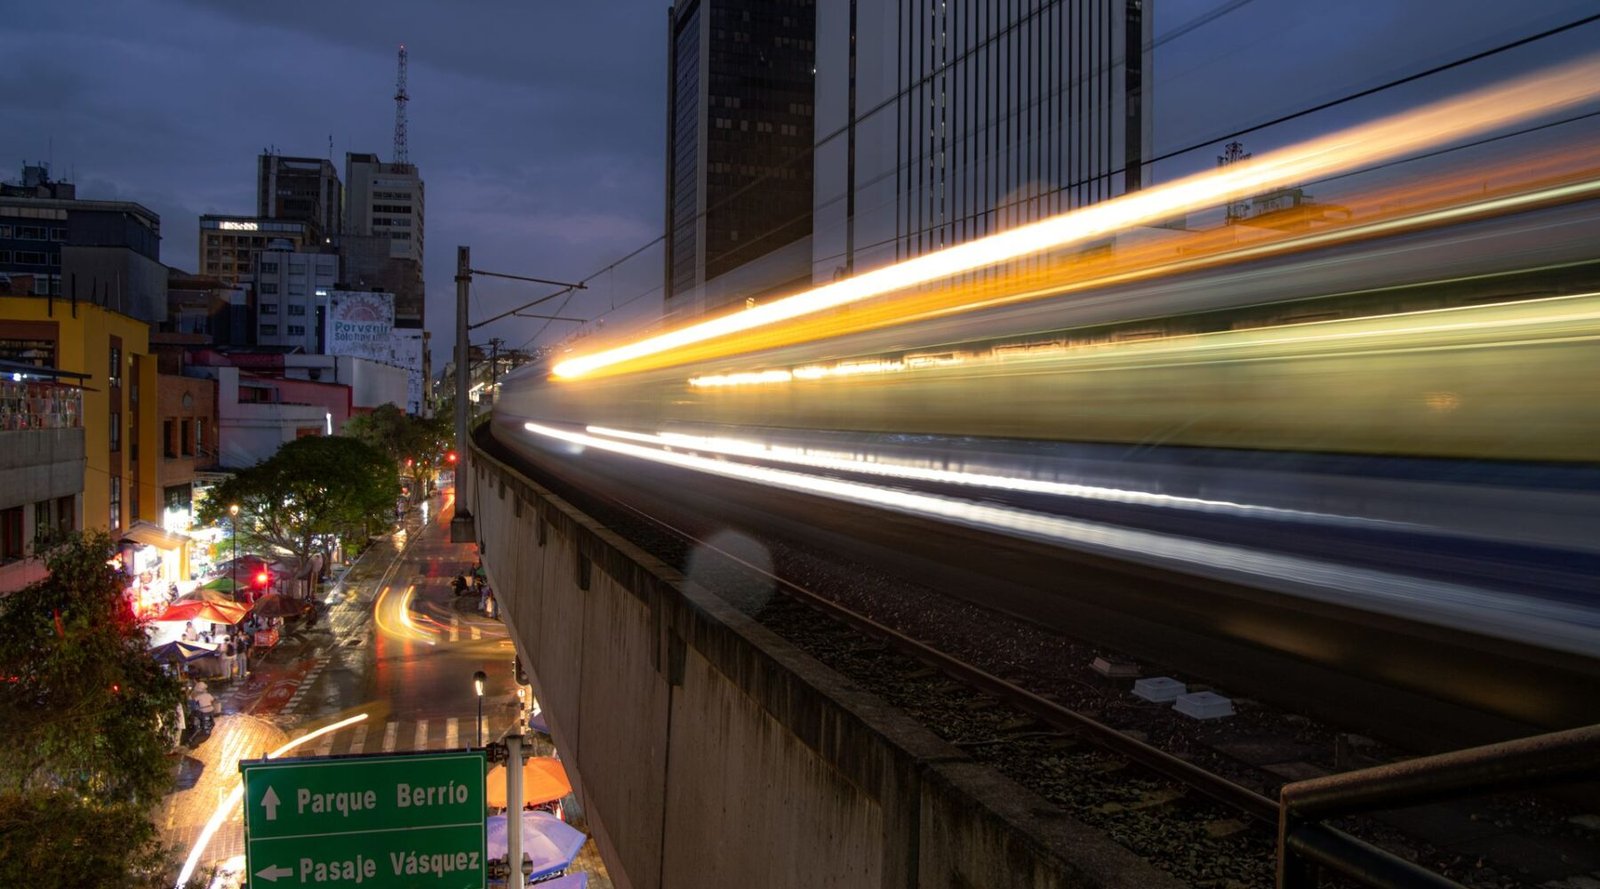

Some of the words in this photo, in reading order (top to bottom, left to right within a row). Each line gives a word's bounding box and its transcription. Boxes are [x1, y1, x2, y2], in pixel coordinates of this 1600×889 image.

[335, 321, 388, 334] Porvenir
[297, 788, 376, 817] Parque
[396, 780, 469, 808] Berrío
[299, 855, 377, 884] Pasaje
[389, 851, 480, 878] Vásquez
